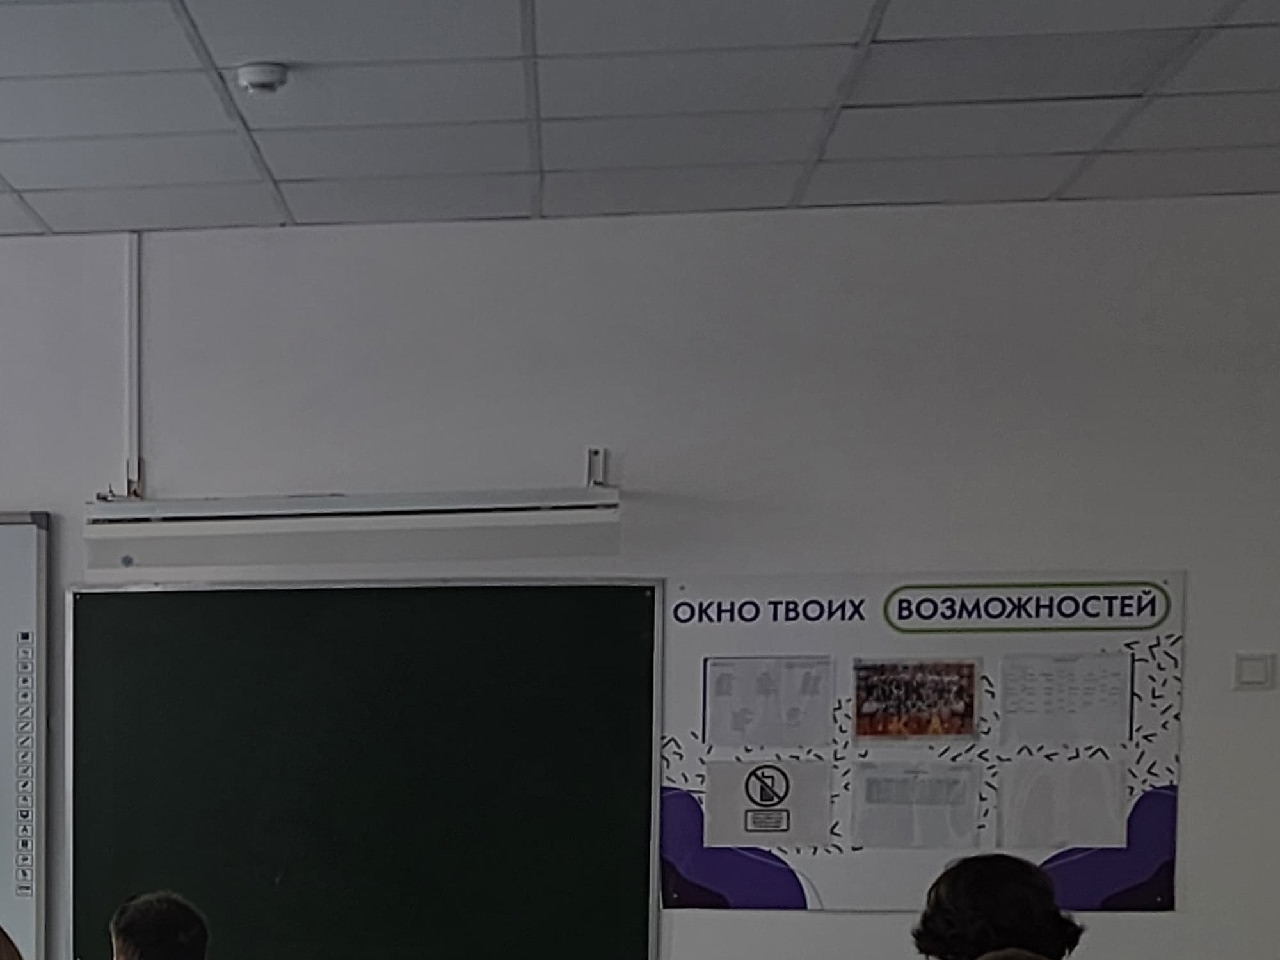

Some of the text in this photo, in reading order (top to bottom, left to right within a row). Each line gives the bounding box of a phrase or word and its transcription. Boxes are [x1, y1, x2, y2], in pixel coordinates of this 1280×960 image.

[672, 589, 1157, 624] ОКНО ТВОИХ ВОЗМОЖНОСТЕЙ
